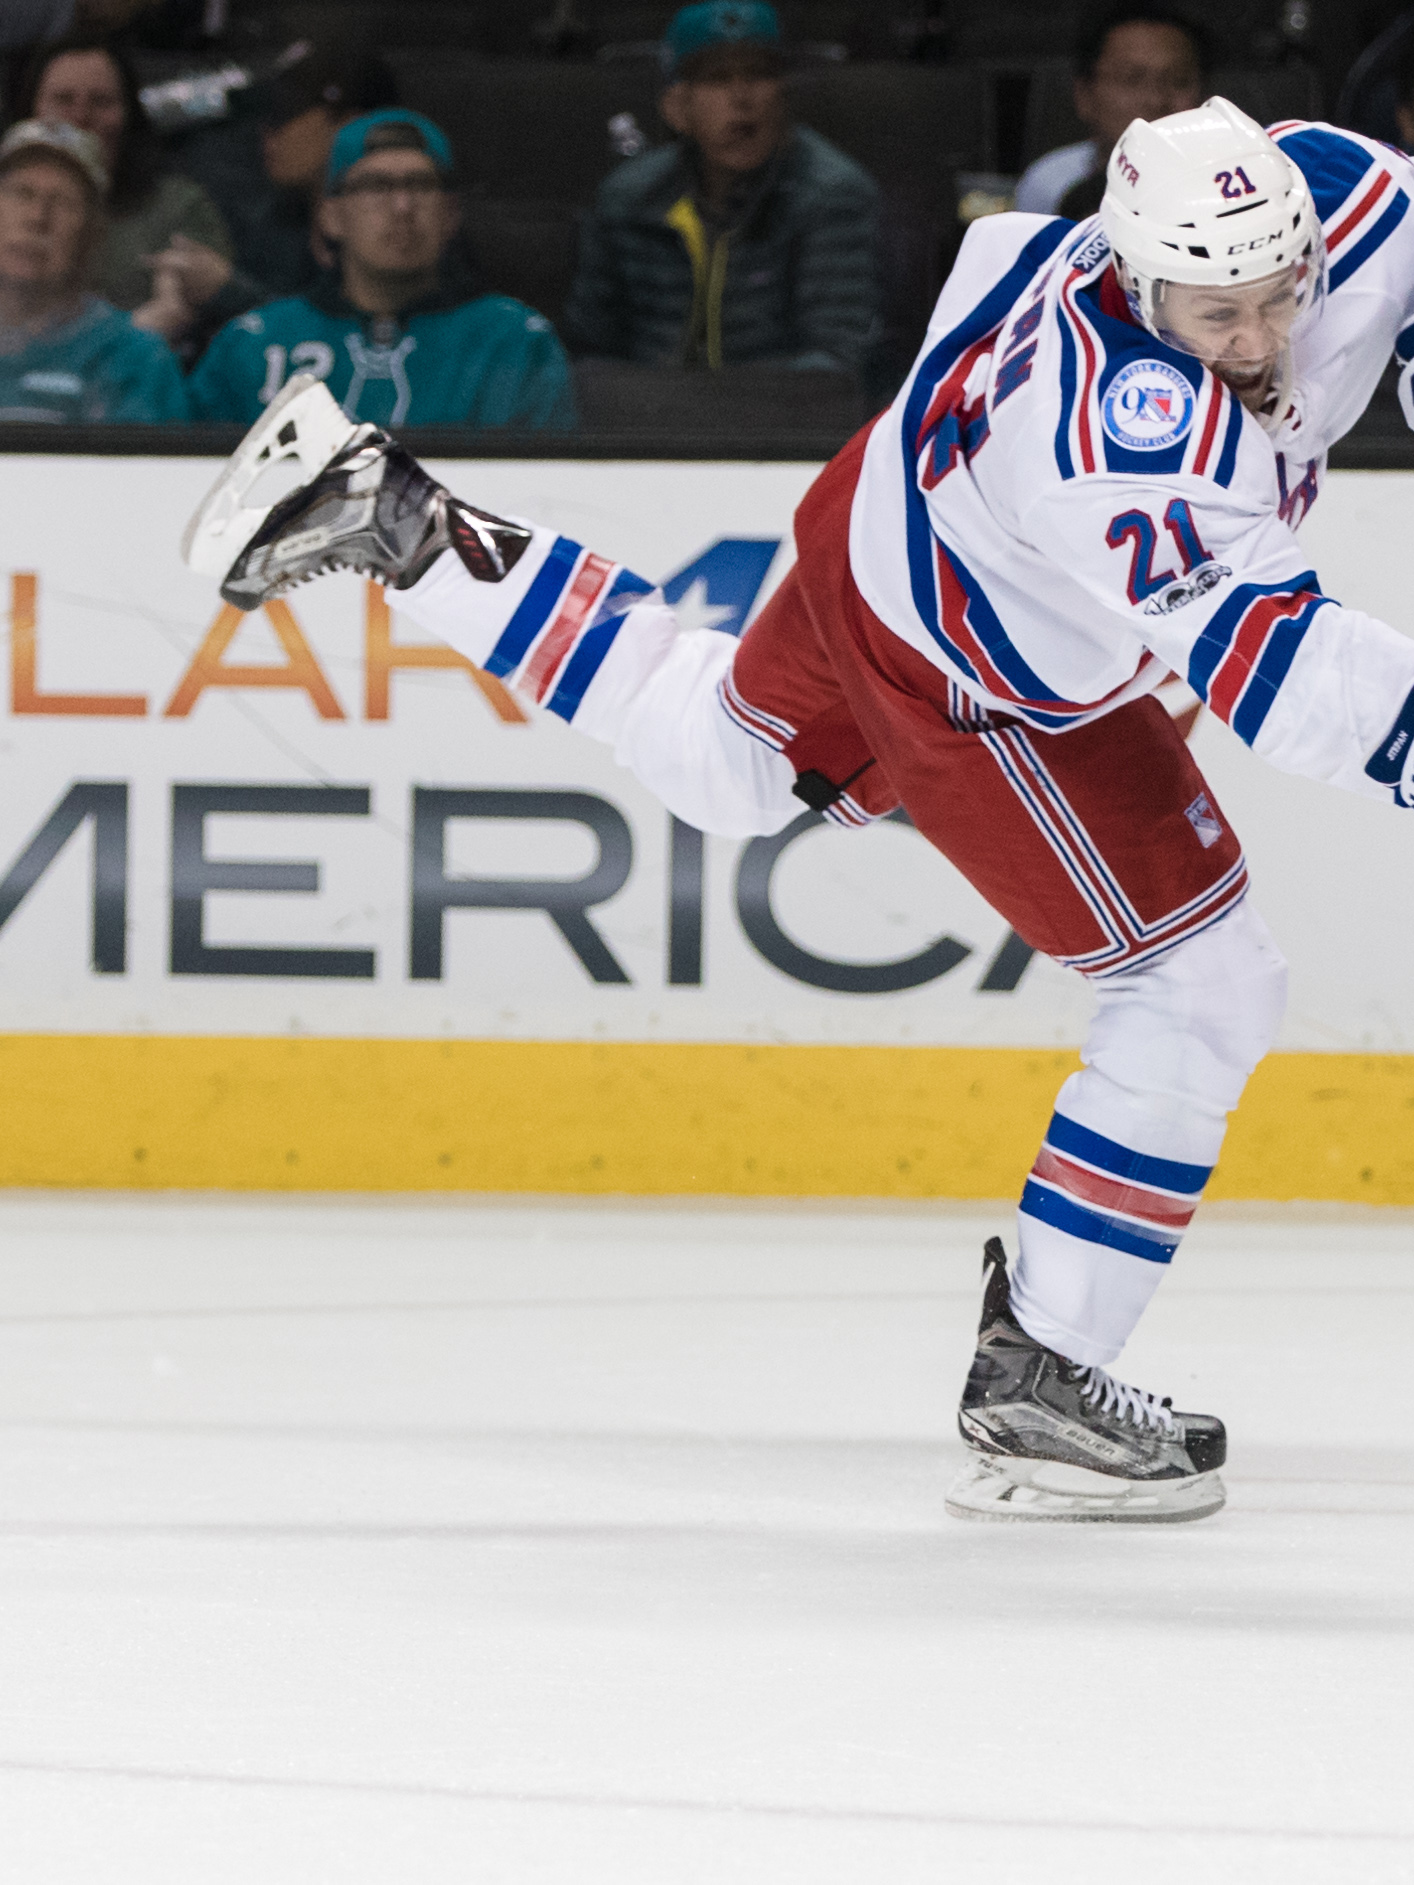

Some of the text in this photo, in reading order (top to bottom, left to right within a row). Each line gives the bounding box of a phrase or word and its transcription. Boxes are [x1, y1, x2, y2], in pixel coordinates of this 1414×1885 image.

[1214, 165, 1257, 199] 21
[1227, 229, 1283, 256] CCM
[1105, 498, 1215, 606] 21
[0, 783, 1036, 993] ERIC
